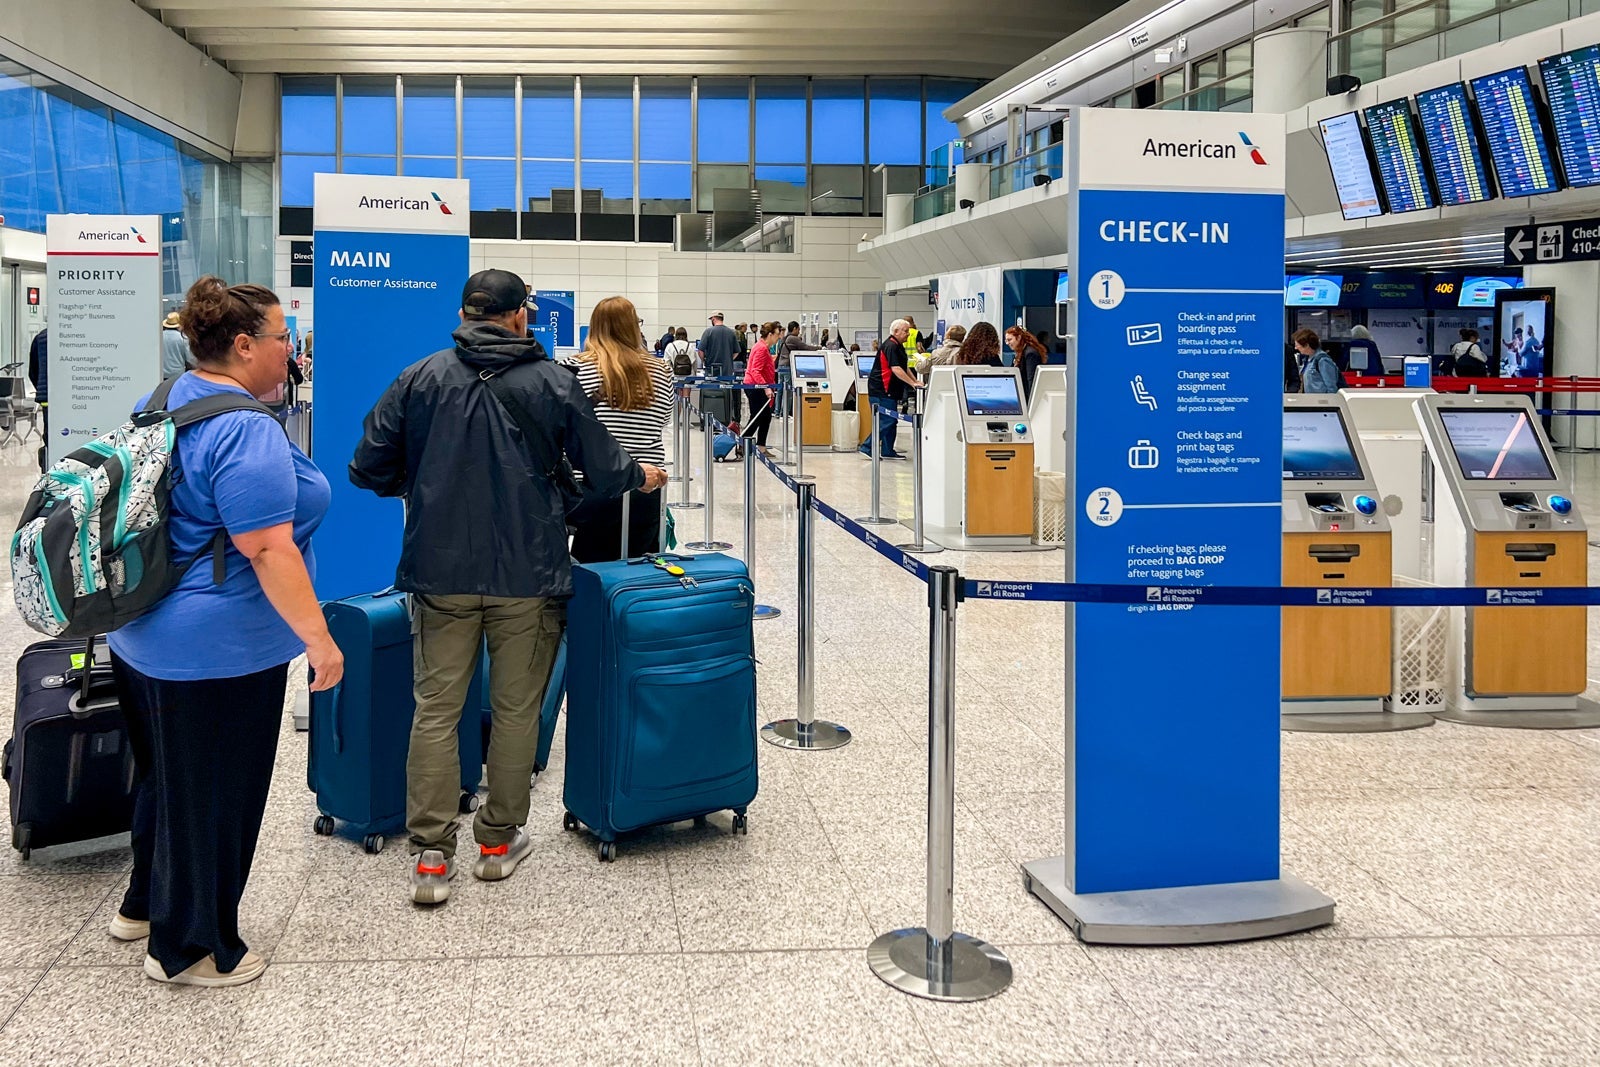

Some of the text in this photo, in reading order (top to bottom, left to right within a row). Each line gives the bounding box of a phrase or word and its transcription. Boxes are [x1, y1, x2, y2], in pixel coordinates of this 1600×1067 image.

[1142, 138, 1236, 158] American
[358, 196, 429, 210] American
[78, 230, 130, 240] American
[1100, 220, 1230, 243] CHECK-IN
[330, 251, 391, 268] MAIN
[58, 270, 125, 280] PRIORITY
[330, 277, 437, 289] Customer Assistance
[1342, 283, 1360, 292] 407
[1102, 281, 1109, 298] 1
[1434, 284, 1454, 293] 406
[951, 298, 976, 309] UNITED
[1178, 312, 1256, 323] Check-in and print
[1372, 320, 1411, 328] American
[1178, 324, 1236, 335] boarding pass
[1177, 371, 1229, 381] Change seat
[1177, 383, 1226, 393] assignment
[1177, 431, 1242, 441] Check bags and
[1177, 443, 1235, 453] print bag tags
[1177, 457, 1202, 465] Registra
[1207, 457, 1230, 465] bagagli
[1099, 497, 1110, 515] 2
[1128, 545, 1135, 554] If
[1136, 545, 1174, 555] checking
[1199, 544, 1226, 553] please
[1128, 555, 1224, 568] proceed to BAG DROP
[1127, 568, 1204, 579] after tagging bags
[993, 583, 1032, 591] Aeroporti
[1163, 587, 1202, 595] Aeroporti
[1333, 589, 1372, 597] Aeroporti
[1503, 589, 1543, 597] Aeroporti
[1333, 596, 1340, 604] di
[1503, 596, 1510, 604] di
